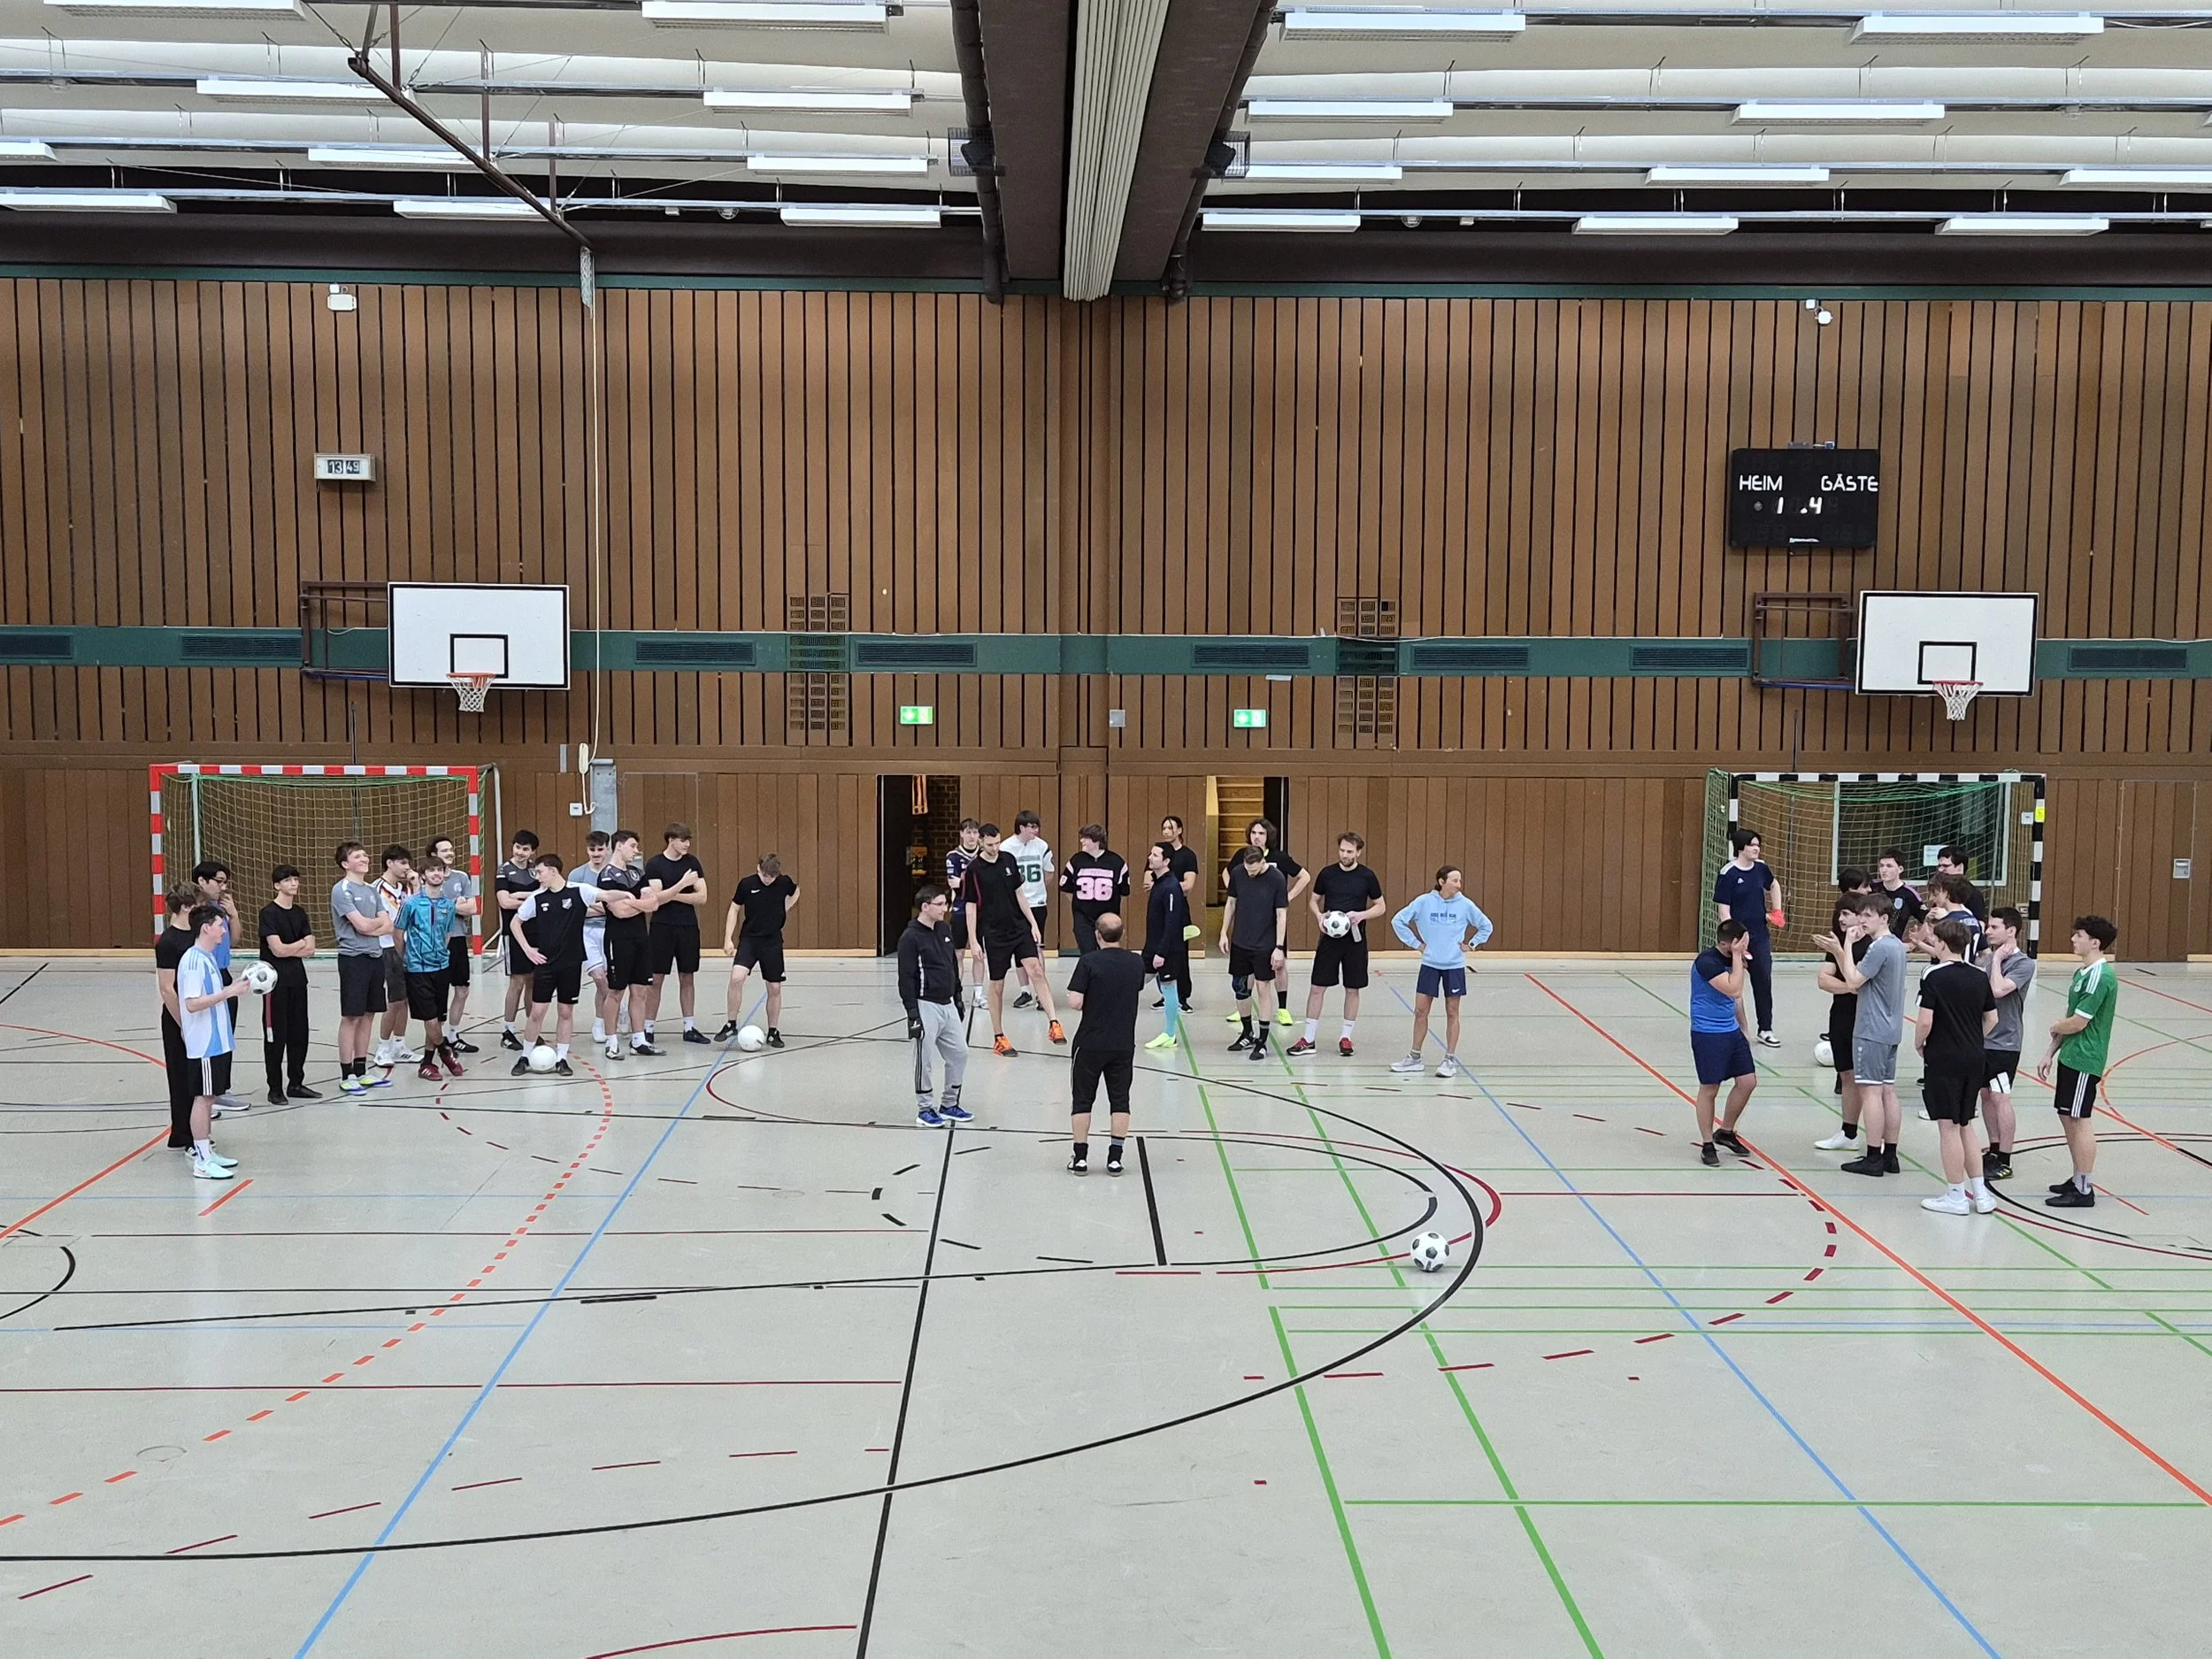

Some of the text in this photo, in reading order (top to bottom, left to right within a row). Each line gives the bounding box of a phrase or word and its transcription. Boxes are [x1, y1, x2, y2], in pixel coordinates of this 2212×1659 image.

[328, 460, 343, 473] 13
[1739, 473, 1878, 492] HEIM GÄSTE
[1076, 877, 1113, 901] 36
